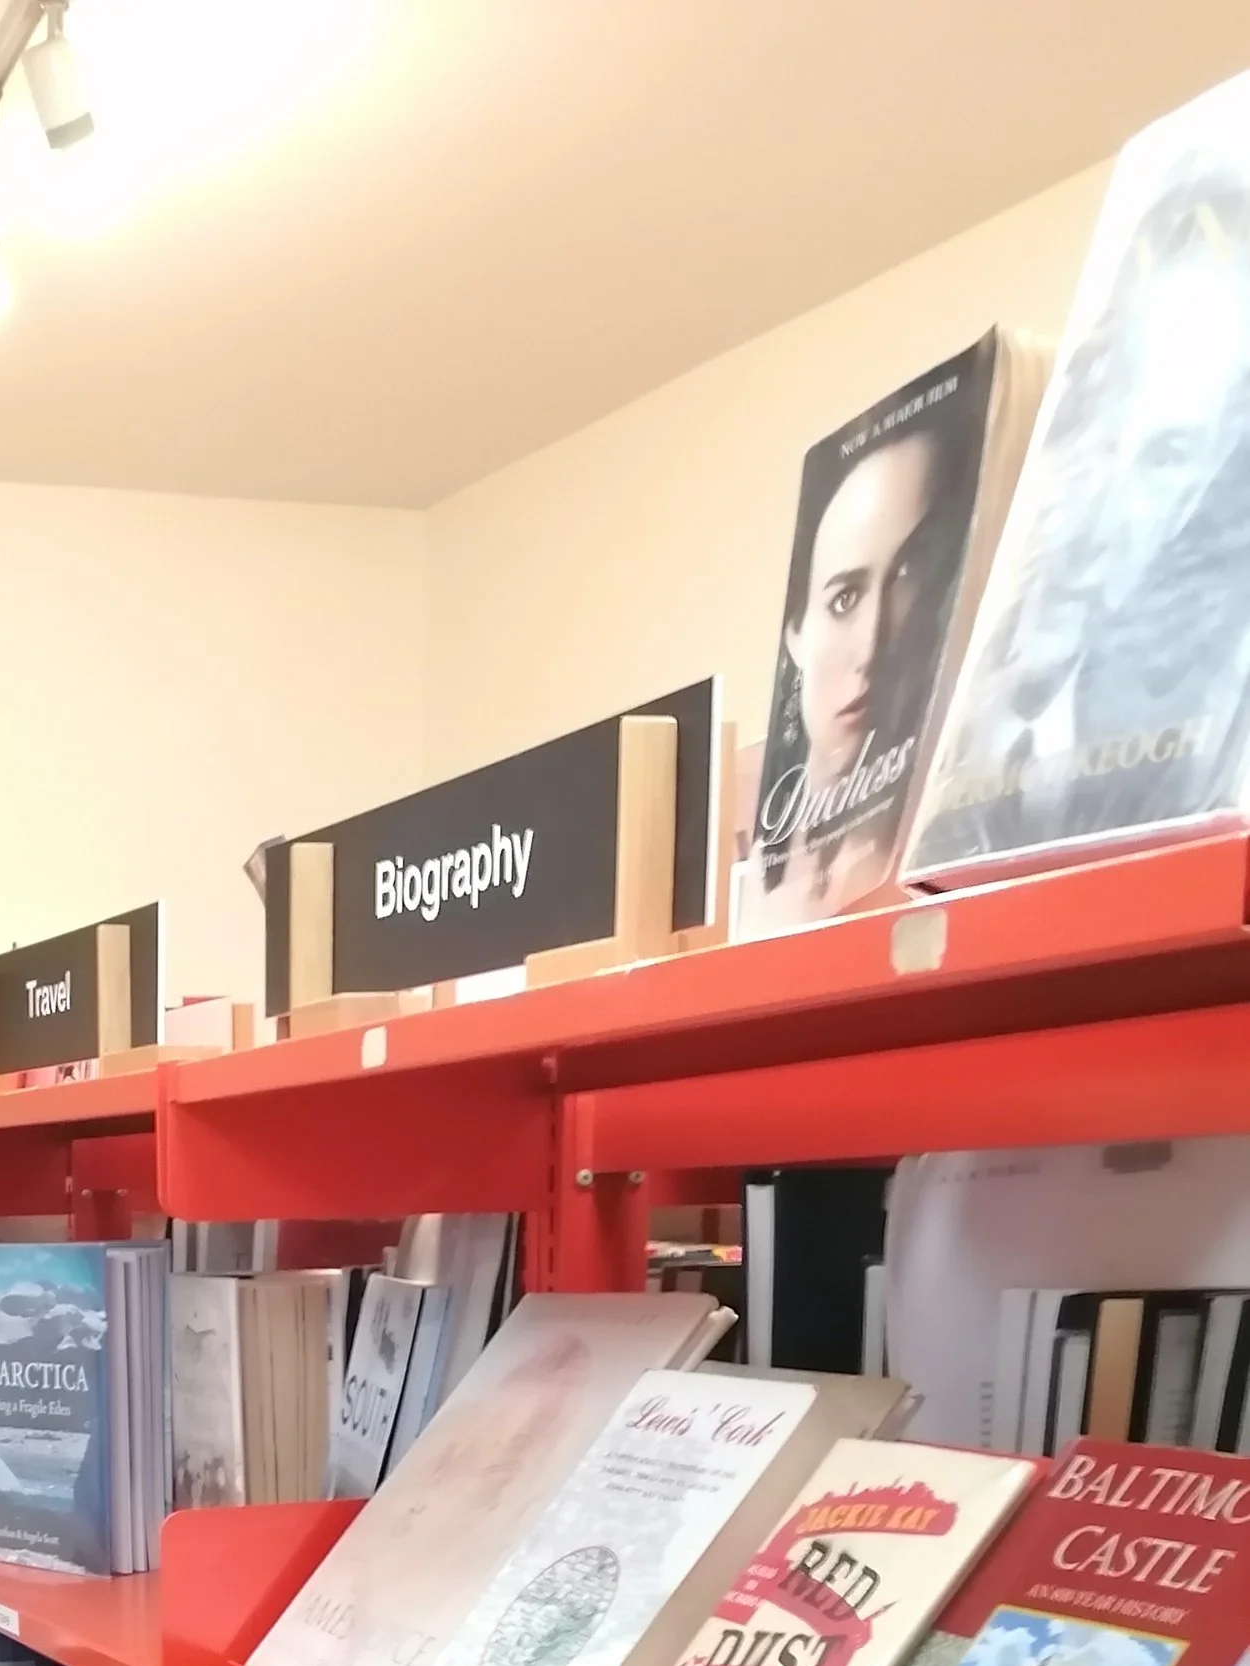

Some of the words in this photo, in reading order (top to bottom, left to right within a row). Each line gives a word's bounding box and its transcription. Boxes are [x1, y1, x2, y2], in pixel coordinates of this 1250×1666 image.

[841, 424, 869, 458] NOW
[760, 727, 917, 846] Duchess
[374, 824, 534, 922] Biography
[26, 970, 71, 1019] Travel
[19, 1399, 47, 1420] Fragile
[49, 1401, 71, 1417] Eden
[342, 1374, 389, 1440] SOUTH
[712, 1404, 785, 1447] Cork
[798, 1503, 887, 1534] JACKIE
[886, 1505, 940, 1531] KAY
[778, 1540, 881, 1621] RED
[1053, 1525, 1237, 1594] CASTLE
[1110, 1598, 1191, 1625] HISTORY
